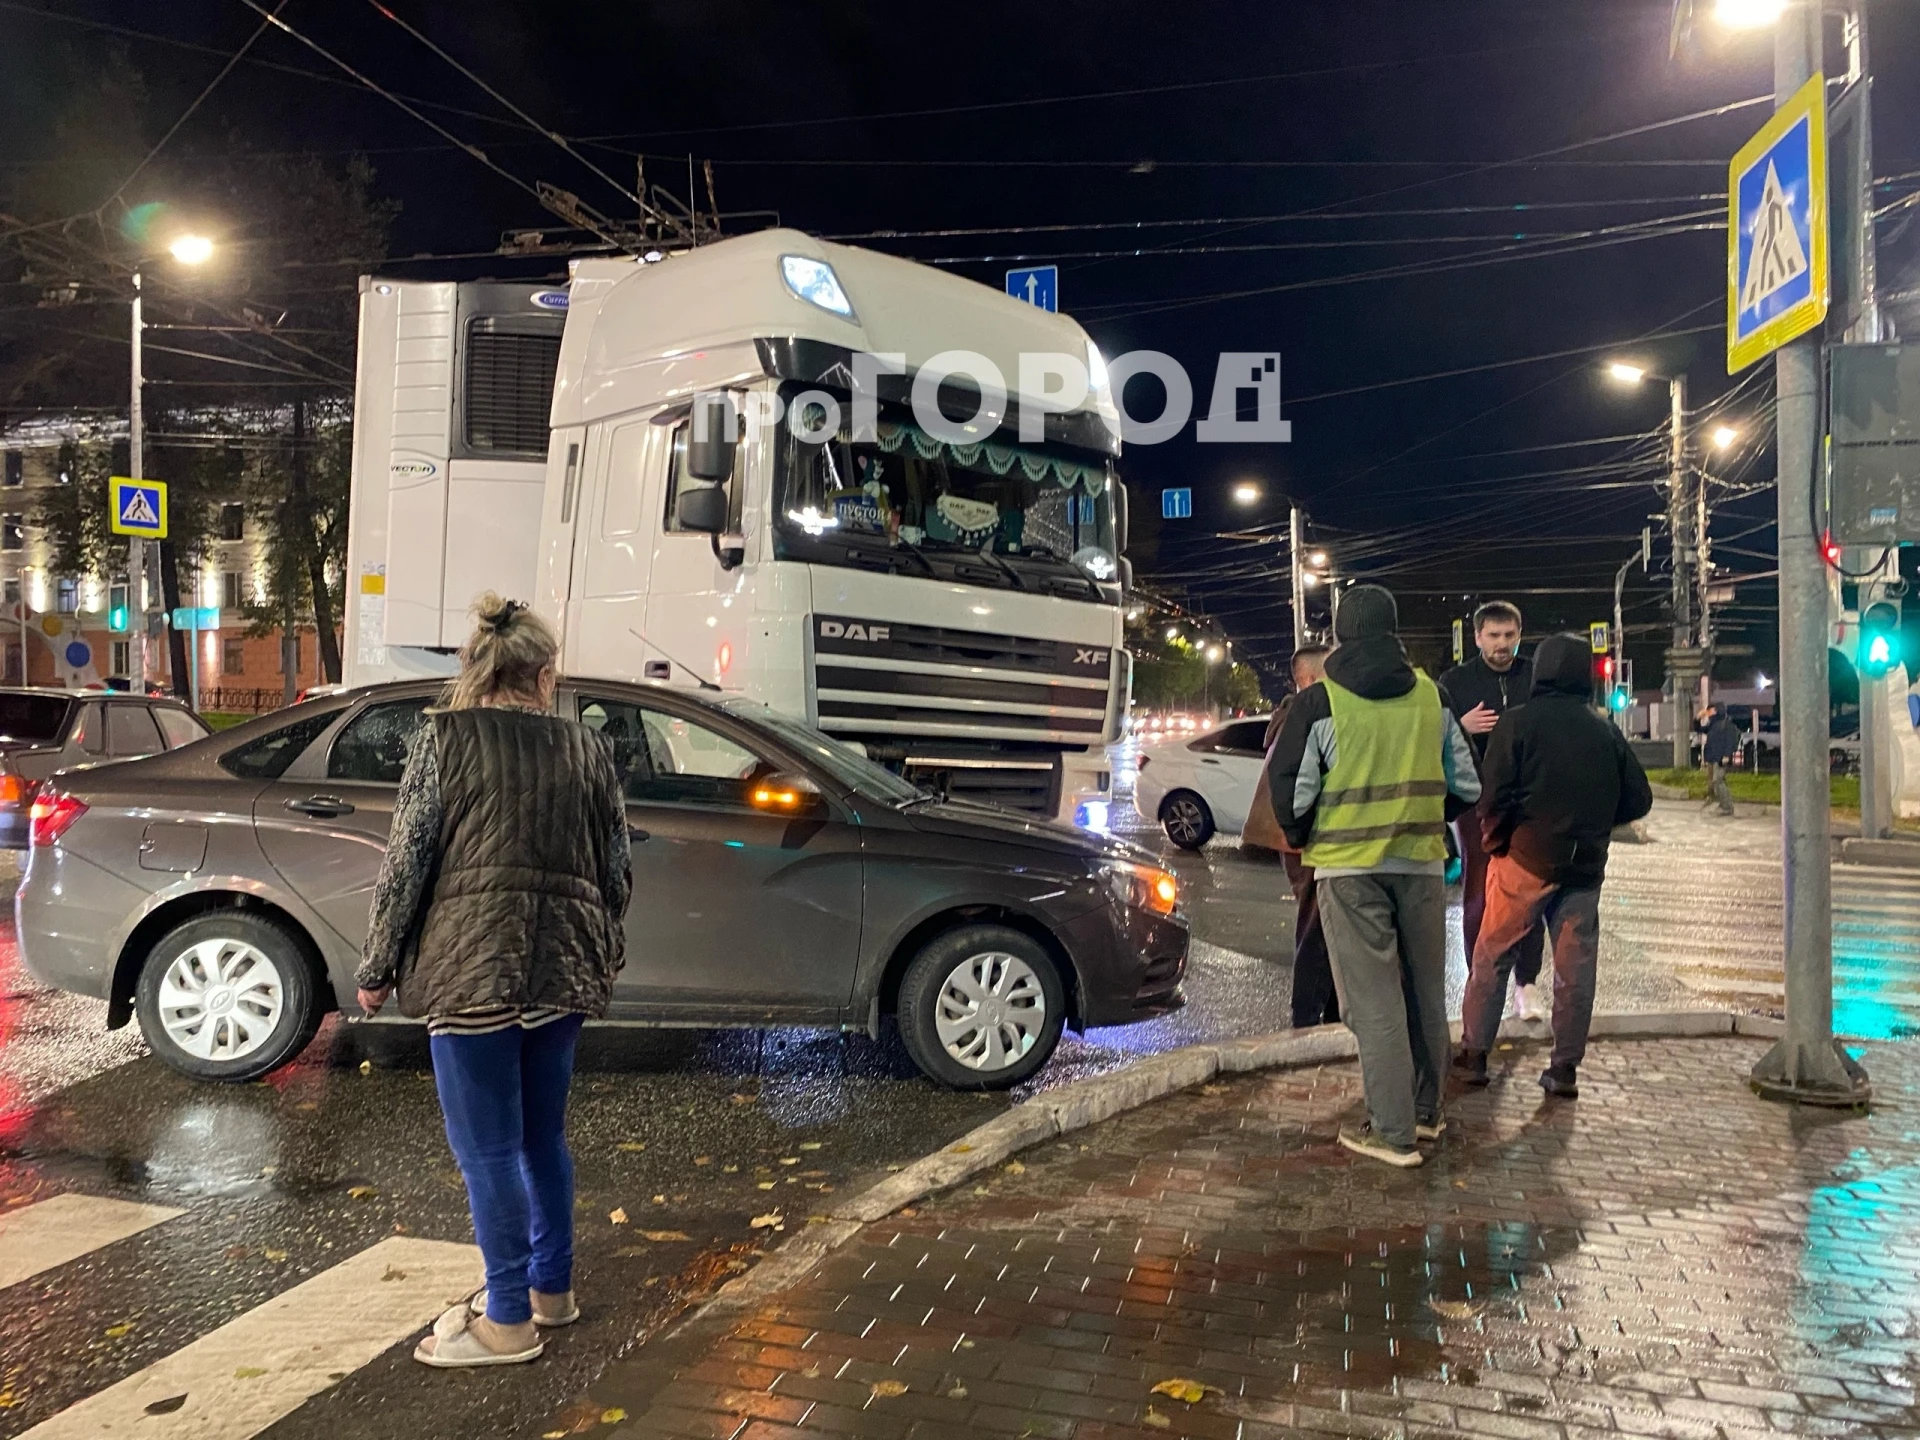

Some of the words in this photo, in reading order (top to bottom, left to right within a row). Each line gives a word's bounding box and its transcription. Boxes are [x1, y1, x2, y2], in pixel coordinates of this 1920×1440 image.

[543, 294, 569, 305] Carrie
[820, 620, 890, 642] DAF
[1072, 649, 1108, 665] XF
